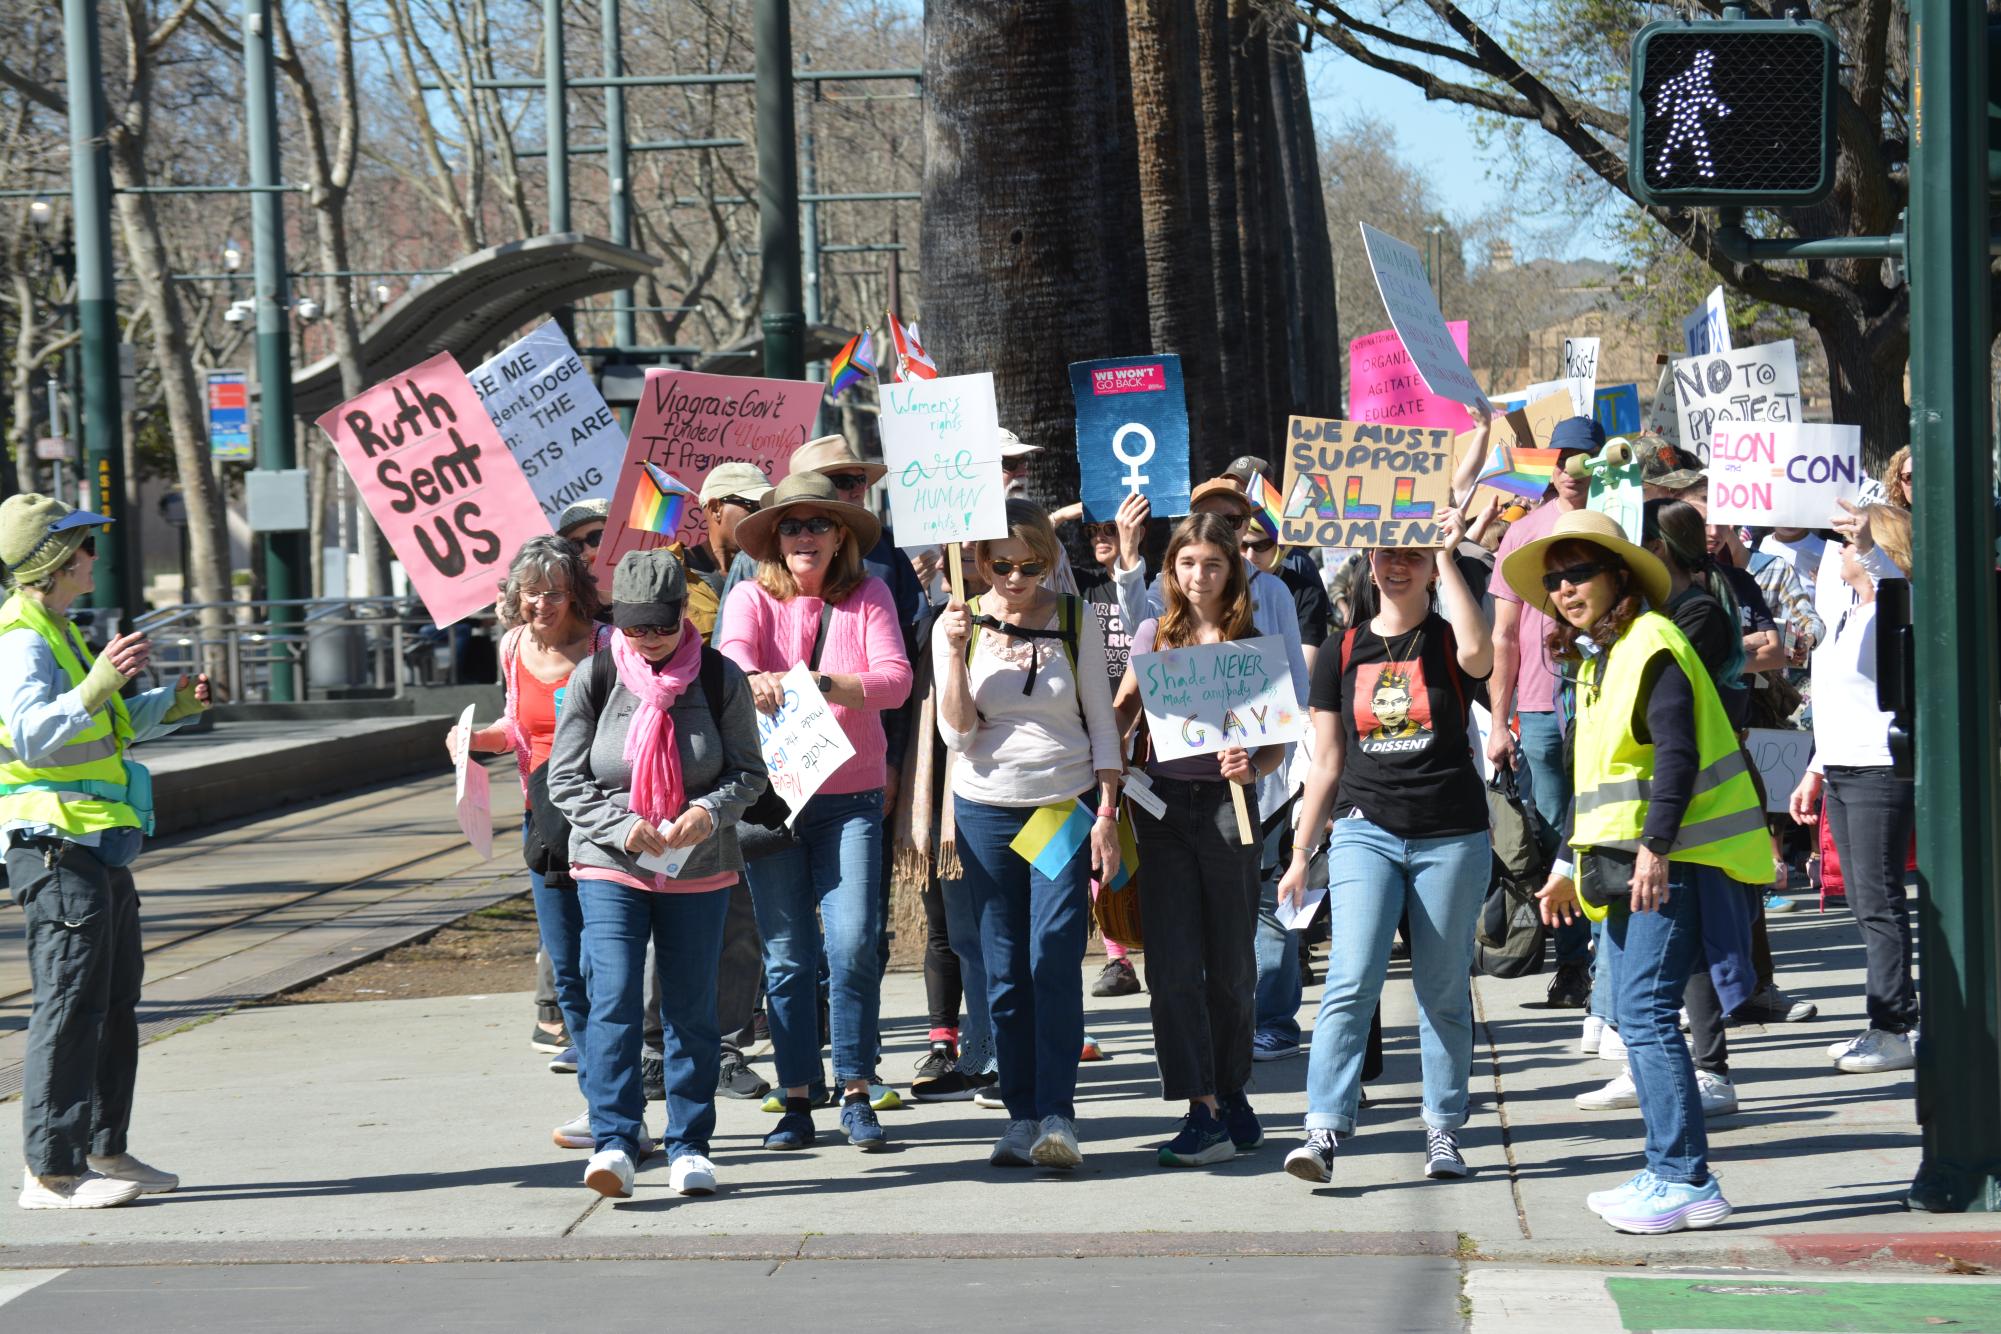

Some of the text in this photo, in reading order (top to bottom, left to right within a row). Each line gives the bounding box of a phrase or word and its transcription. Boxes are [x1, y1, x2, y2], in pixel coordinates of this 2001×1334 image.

[501, 352, 537, 382] ME
[1094, 367, 1154, 381] WE WON'T
[1566, 339, 1595, 379] Resist
[529, 357, 582, 401] DOGE
[1096, 380, 1114, 390] GO
[1116, 378, 1146, 388] BACK.
[1368, 373, 1421, 398] AGITATE
[1674, 359, 1732, 407] NO
[1736, 362, 1776, 388] TO
[529, 393, 575, 429] THE
[655, 377, 720, 425] Viagra
[890, 386, 961, 415] Women's
[1365, 398, 1425, 421] EDUCATE
[345, 379, 457, 458] Ruth
[664, 412, 720, 442] funded
[930, 415, 963, 439] rights
[522, 406, 613, 477] STS ARE
[1291, 419, 1449, 450] WE MUST
[1712, 432, 1775, 464] ELON
[635, 436, 681, 468] If
[1292, 443, 1449, 475] SUPPORT
[377, 427, 482, 514] Sent
[901, 449, 979, 488] are
[1725, 464, 1742, 472] and
[1786, 454, 1855, 484] CON
[540, 467, 603, 516] AKING
[913, 484, 986, 513] HUMAN
[1283, 473, 1436, 520] ALL
[1716, 482, 1773, 511] DON
[413, 501, 501, 578] US
[1147, 654, 1268, 697] Shade NEVER
[1162, 694, 1193, 707] made
[1202, 680, 1251, 710] anybody
[1181, 705, 1268, 748] GAY
[767, 746, 789, 772] USA
[1362, 737, 1431, 753] I DISSENT
[768, 771, 803, 798] Neve
